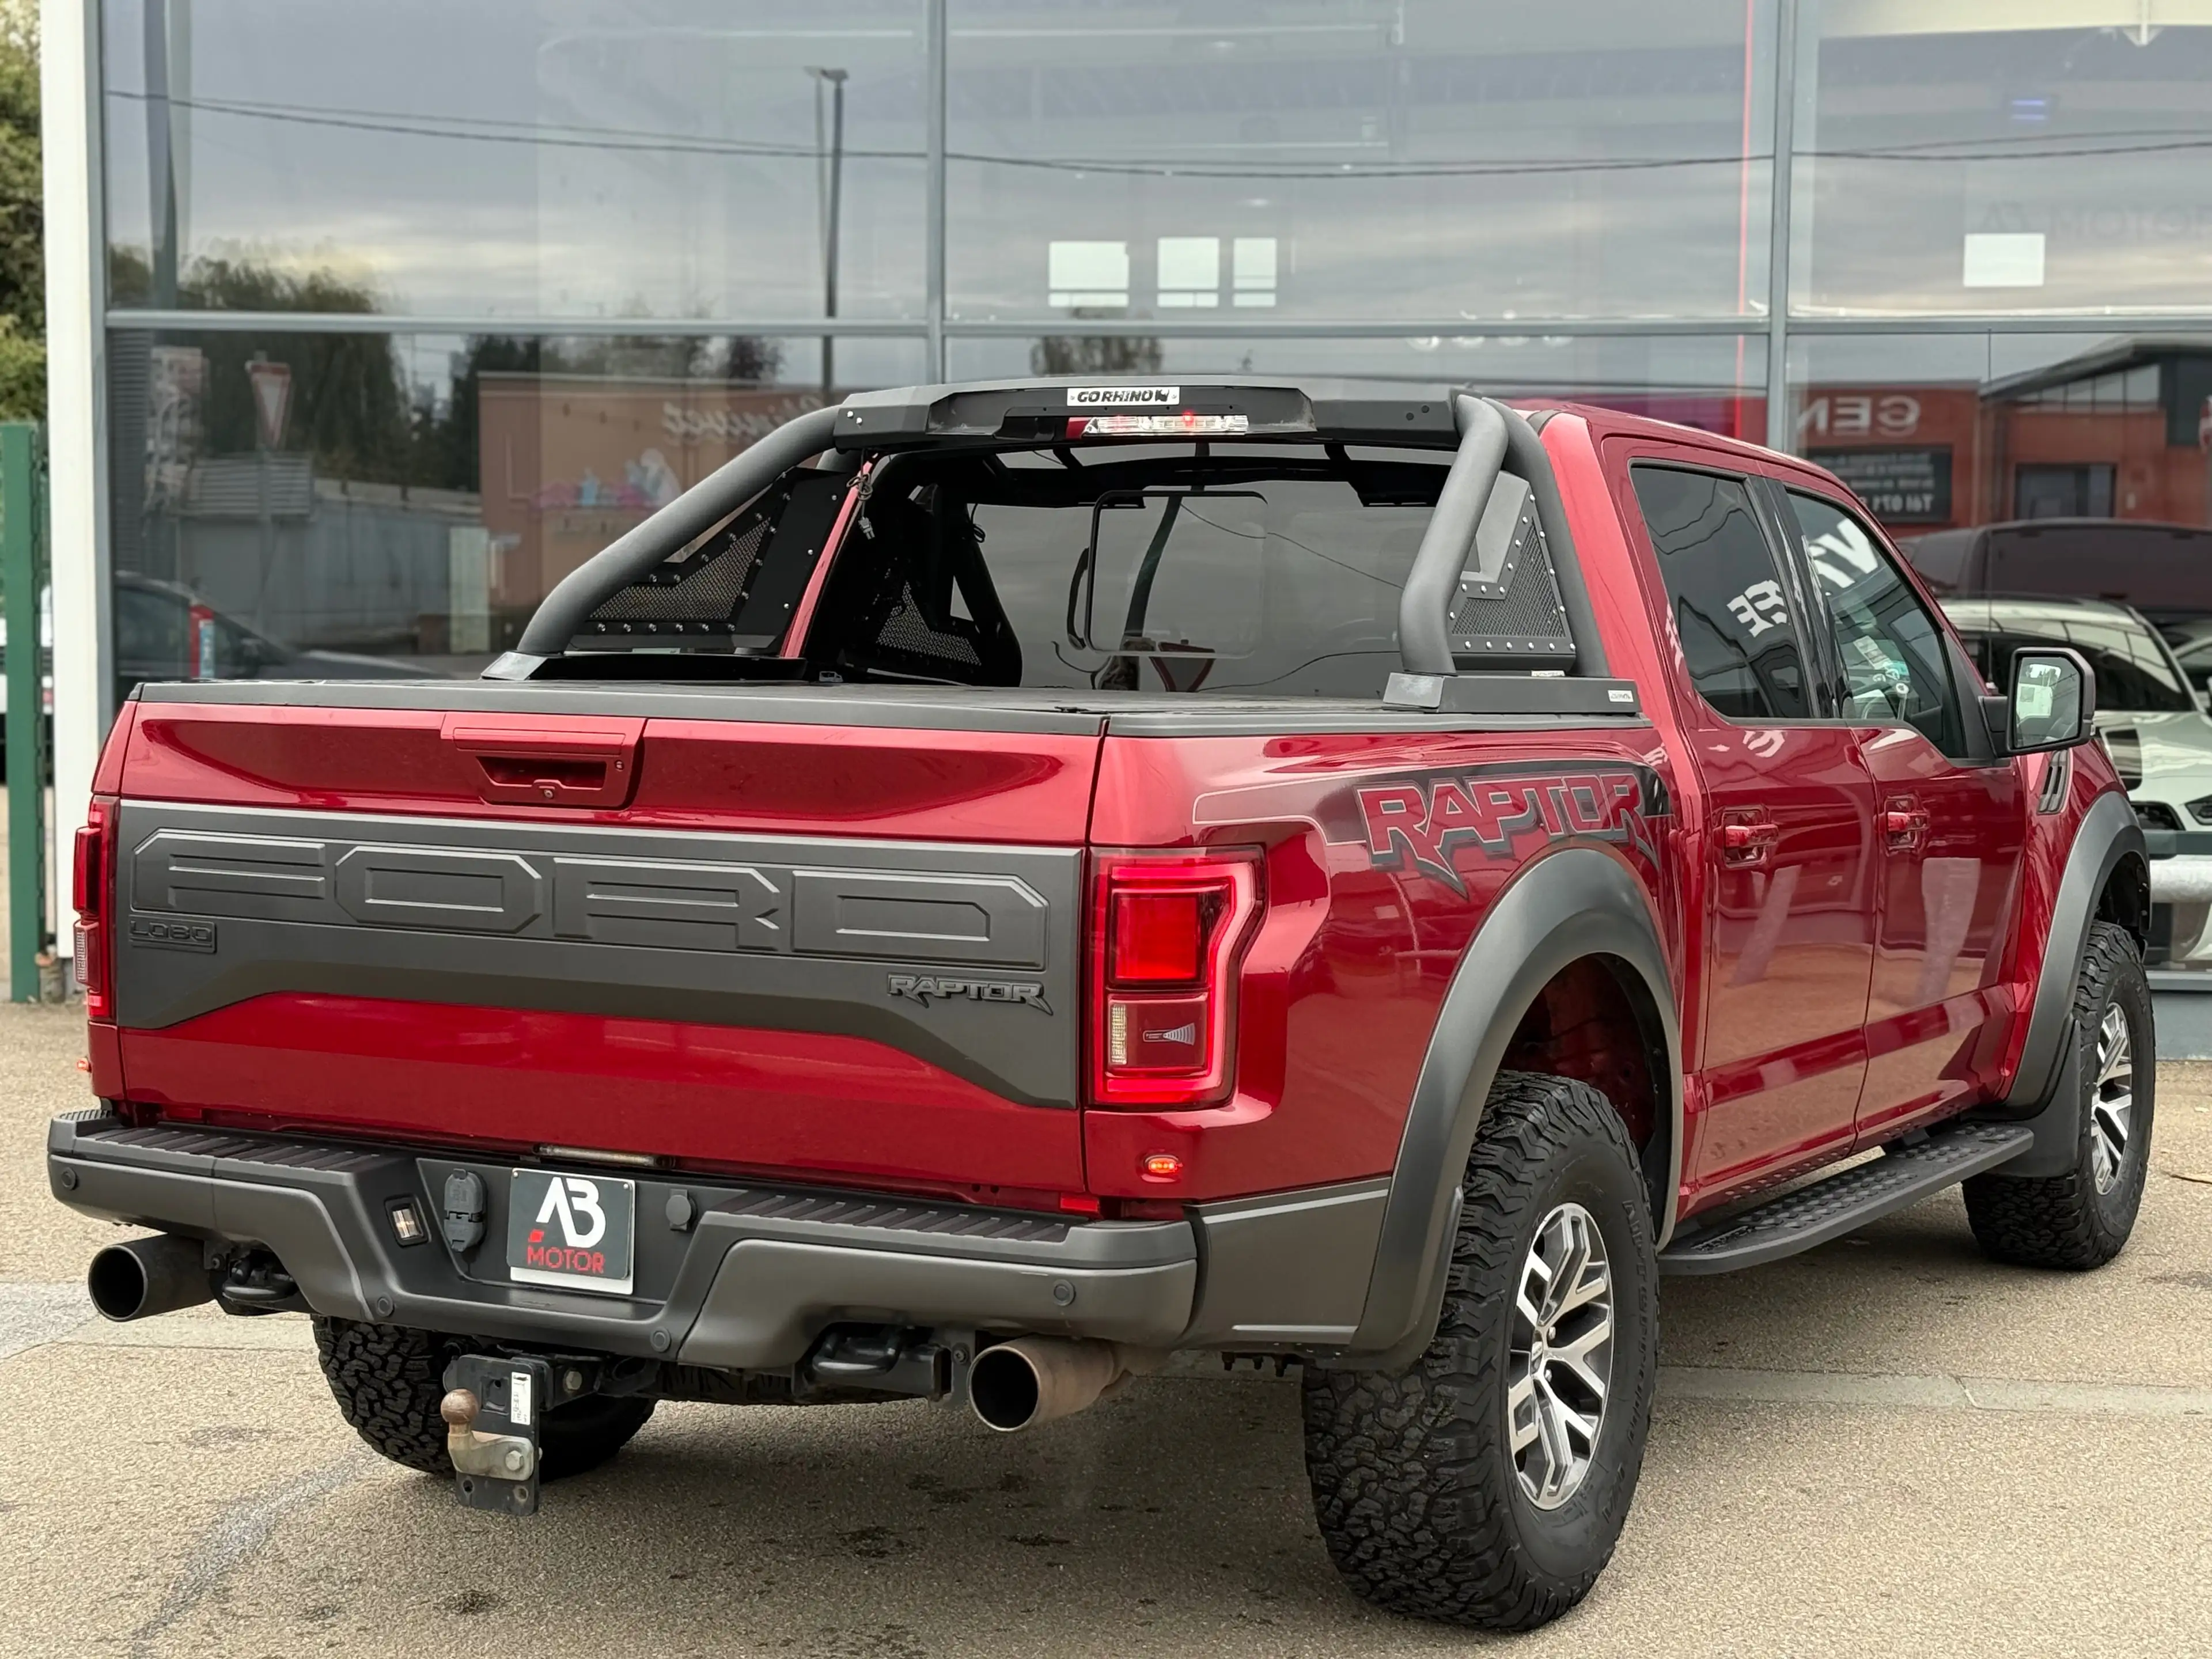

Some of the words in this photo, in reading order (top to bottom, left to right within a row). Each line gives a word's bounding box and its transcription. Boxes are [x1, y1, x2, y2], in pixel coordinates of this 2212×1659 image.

[1355, 770, 1659, 899] RAPTOR
[131, 827, 1050, 972] FORD
[887, 972, 1054, 1016] RAPTOR
[535, 1176, 607, 1248] AB
[527, 1246, 605, 1274] MOTOR
